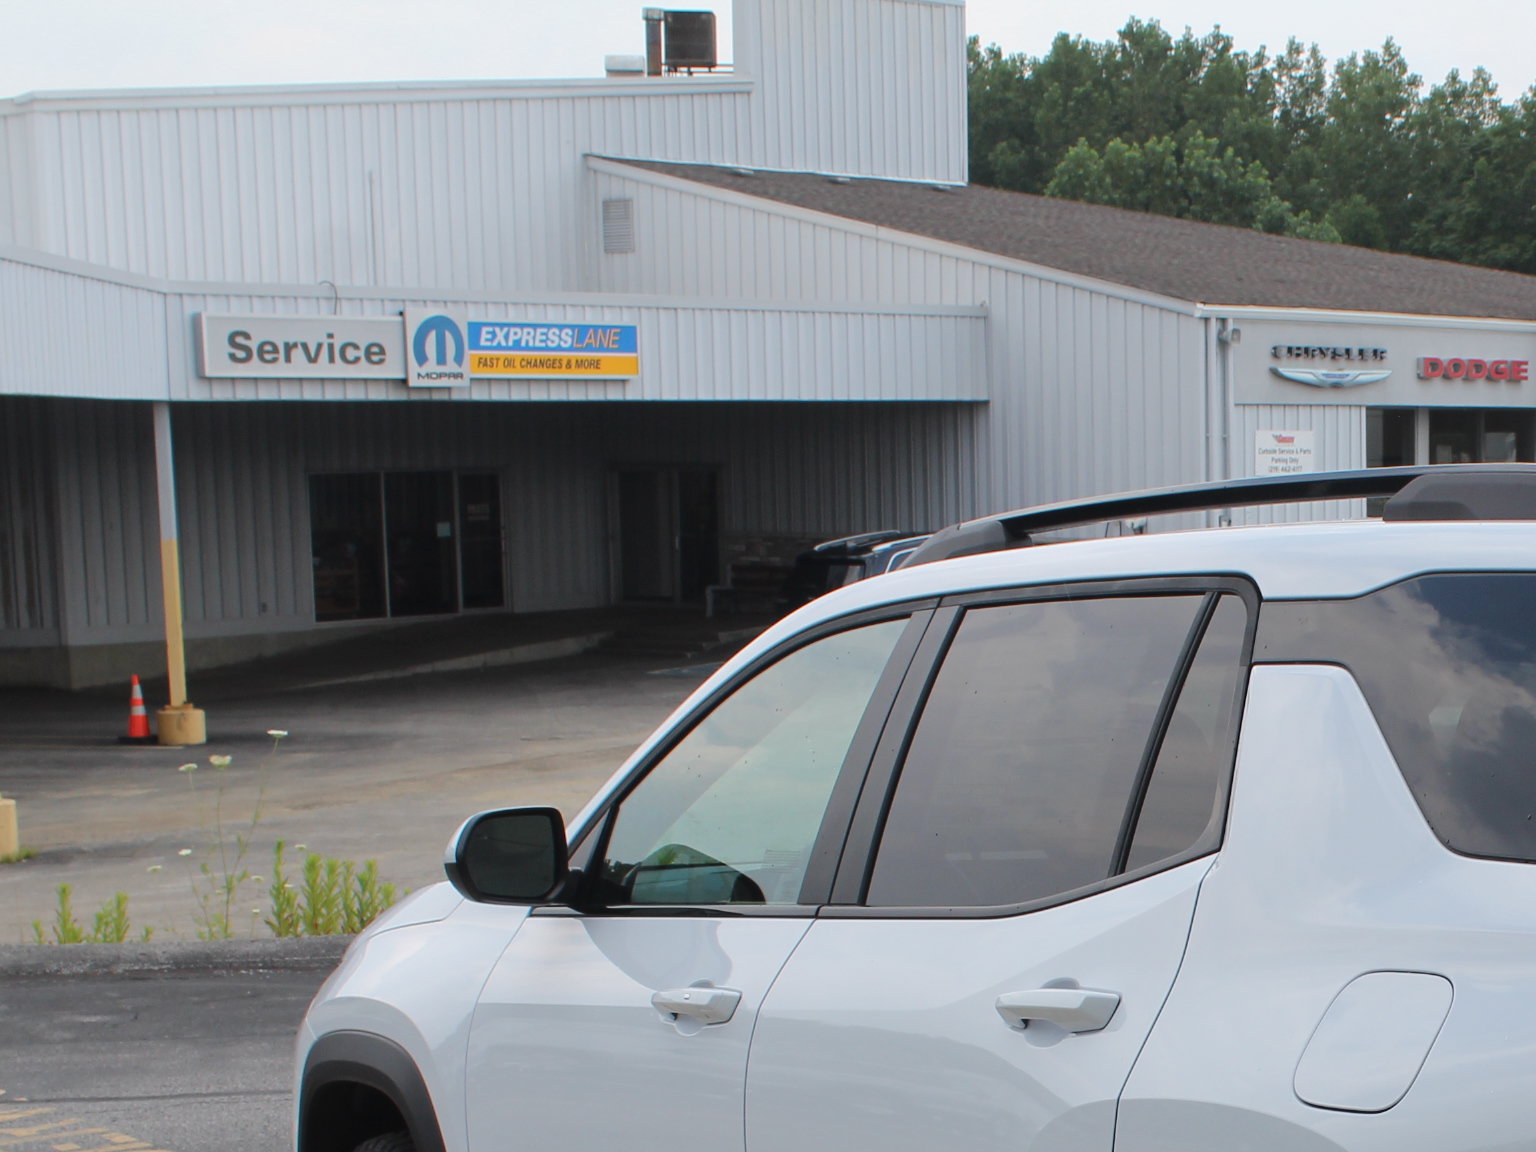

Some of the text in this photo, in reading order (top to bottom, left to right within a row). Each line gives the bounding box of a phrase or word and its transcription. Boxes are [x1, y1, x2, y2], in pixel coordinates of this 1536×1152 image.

[227, 330, 387, 366] Service
[1270, 345, 1388, 362] CHRYSLER
[477, 356, 602, 370] FAST OIL CHANGES & MORE
[1420, 357, 1529, 381] DODGE
[417, 372, 464, 381] MOPAR
